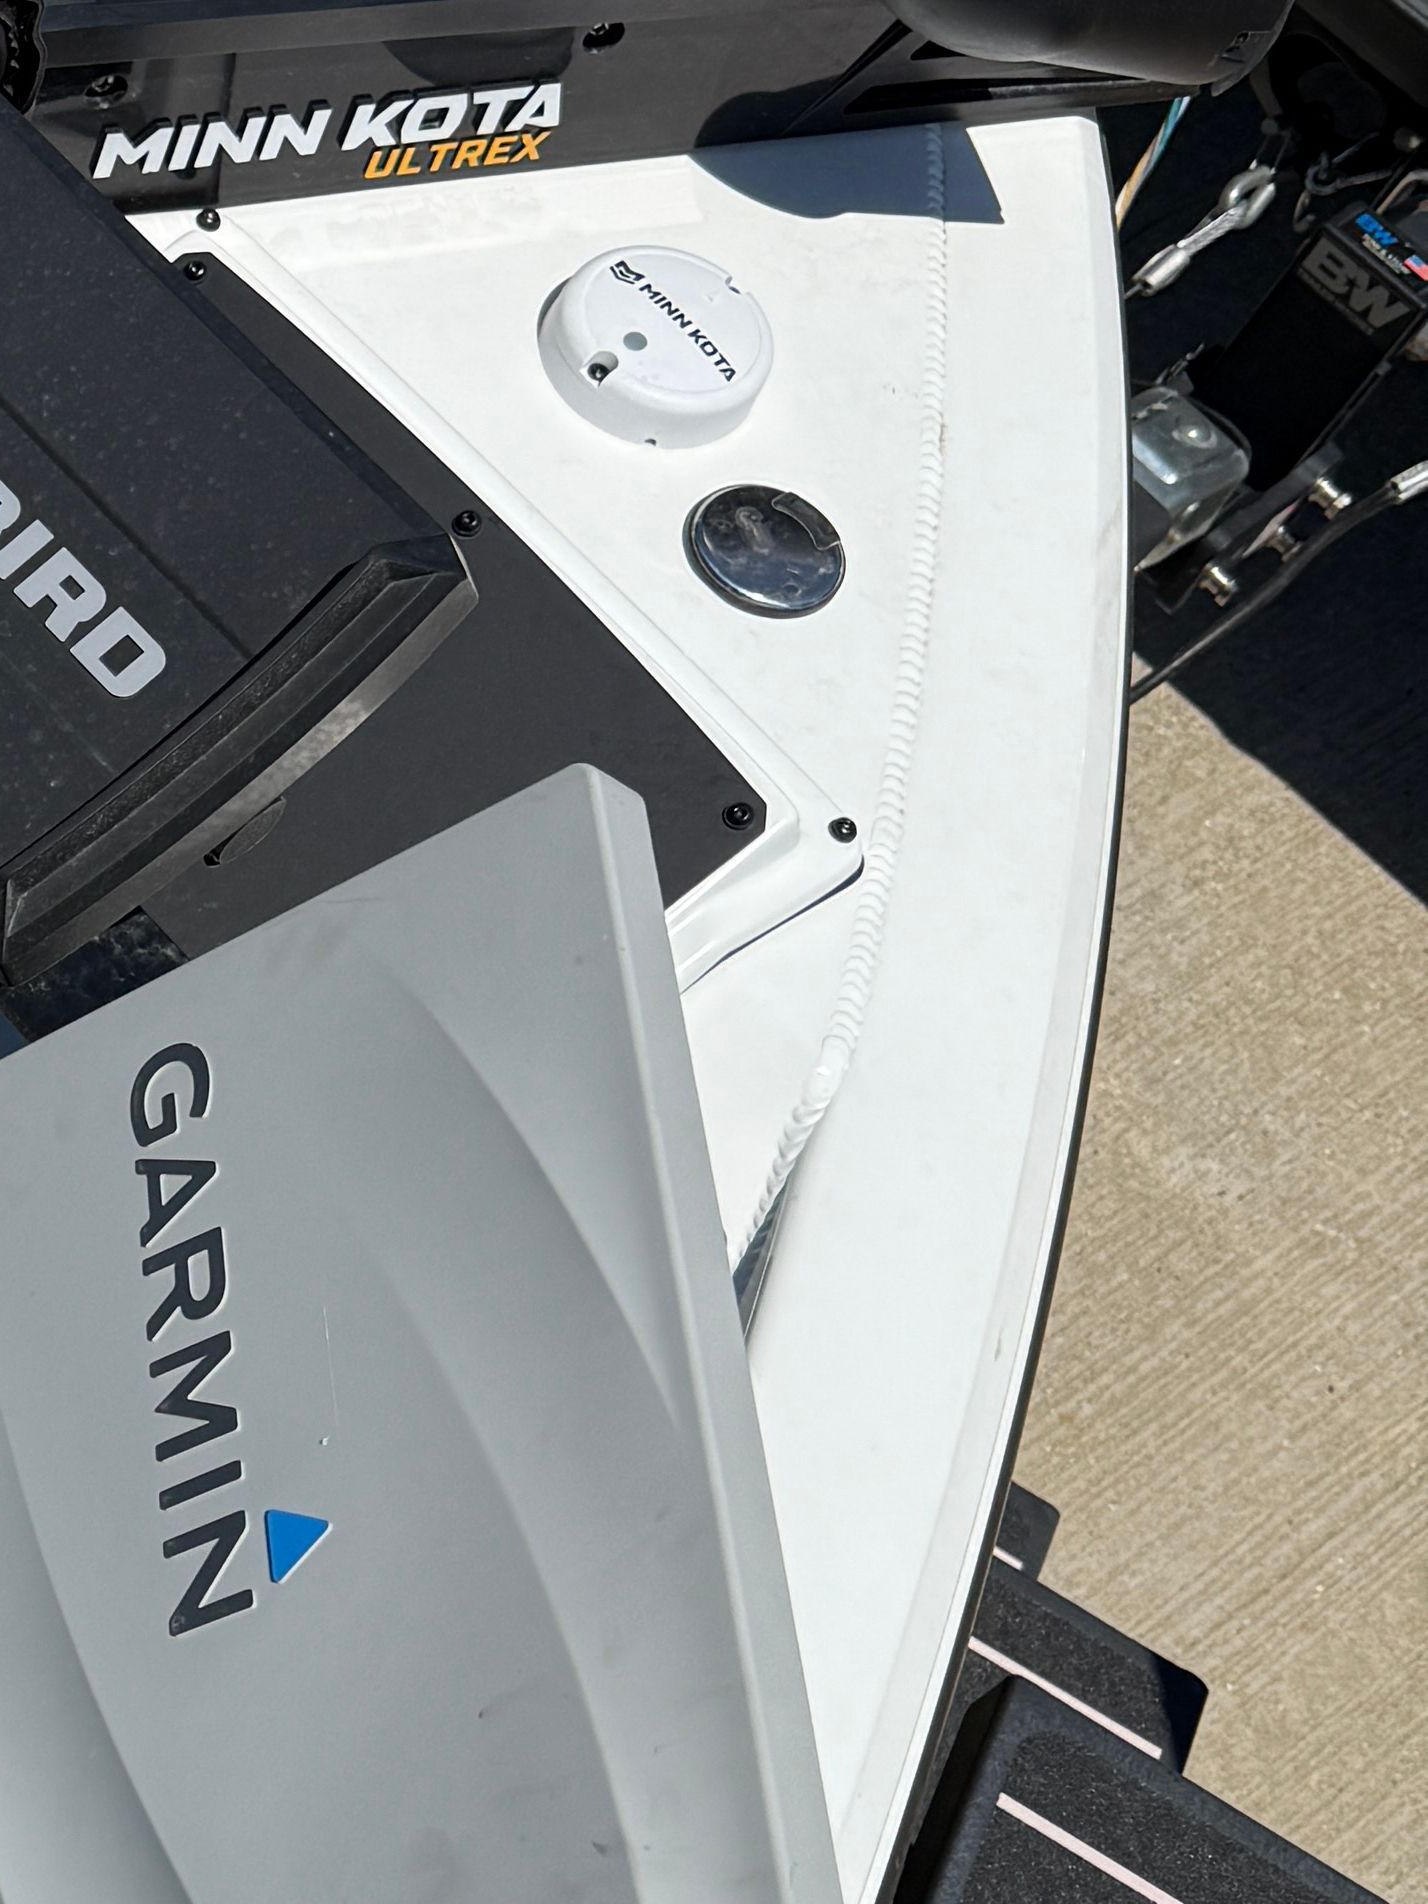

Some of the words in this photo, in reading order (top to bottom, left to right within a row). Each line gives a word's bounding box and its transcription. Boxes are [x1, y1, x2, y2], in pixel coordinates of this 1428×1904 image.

[91, 104, 332, 179] MINN
[341, 82, 562, 151] KOTA
[363, 131, 551, 181] ULTREX
[638, 283, 693, 329] MINN
[687, 328, 736, 382] KOTA
[129, 1041, 255, 1638] GARMIN
